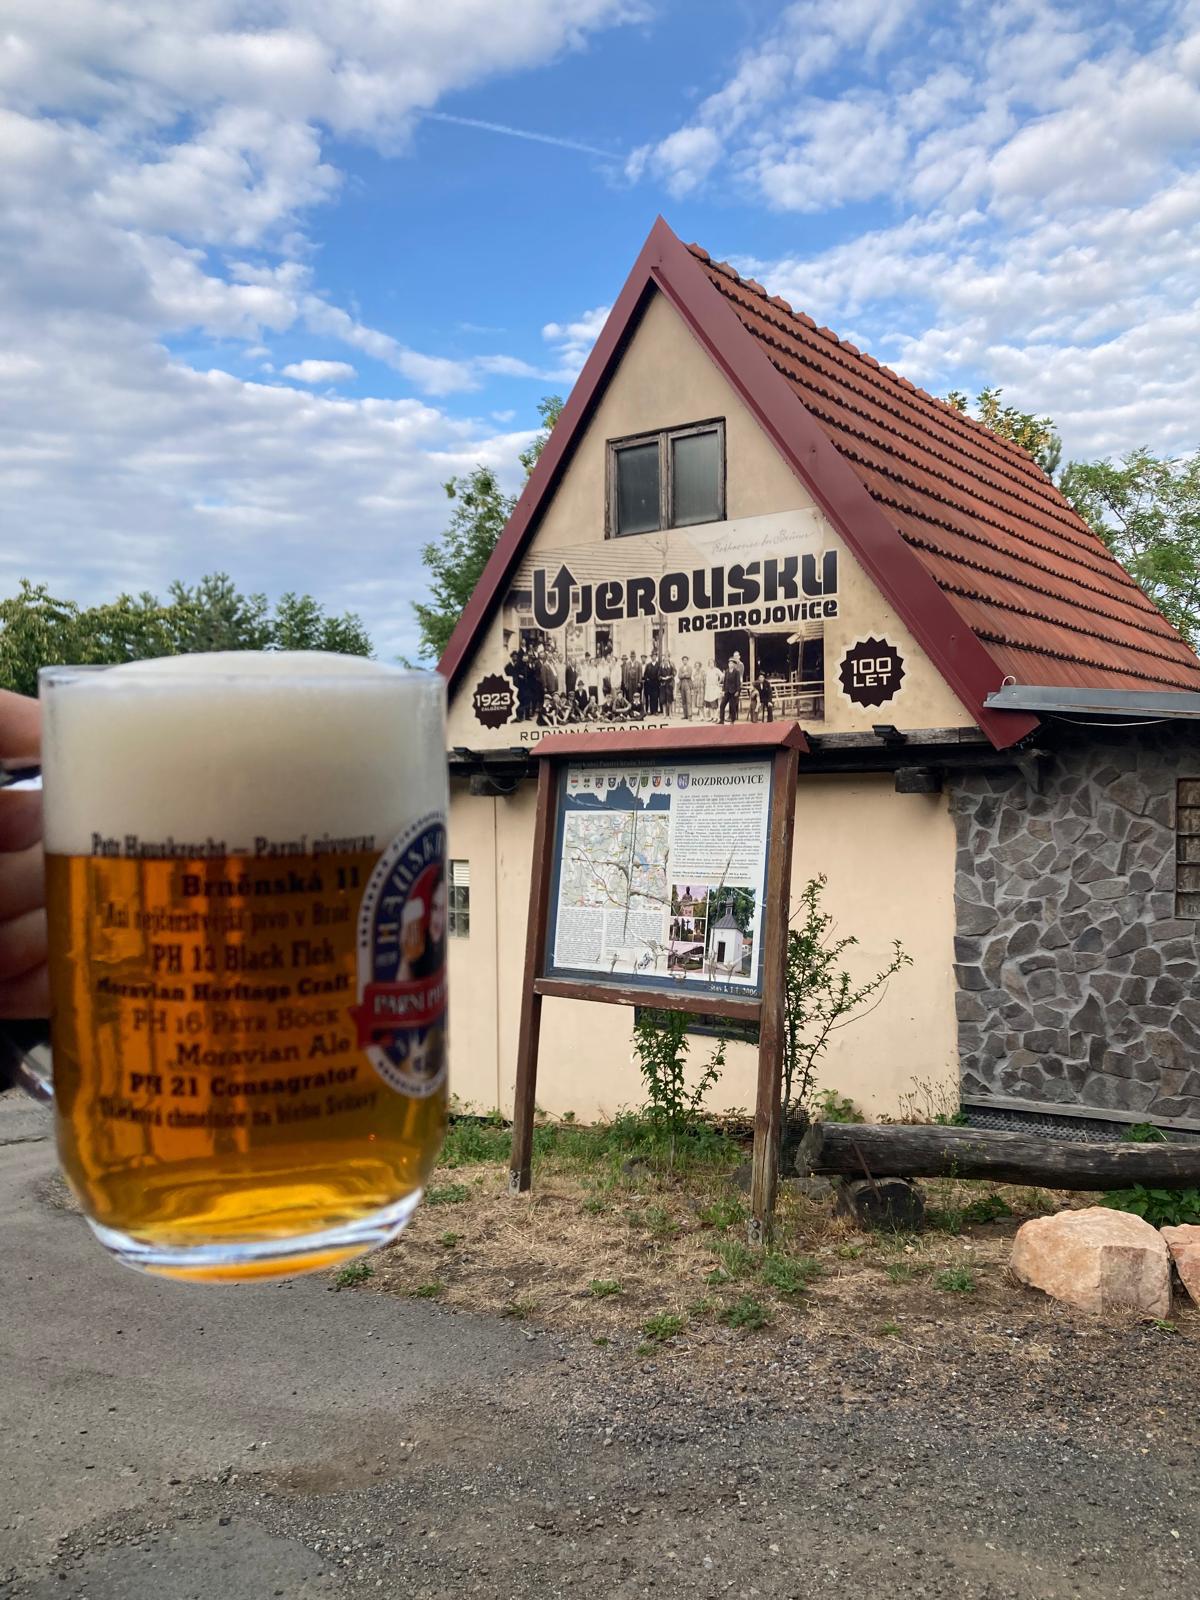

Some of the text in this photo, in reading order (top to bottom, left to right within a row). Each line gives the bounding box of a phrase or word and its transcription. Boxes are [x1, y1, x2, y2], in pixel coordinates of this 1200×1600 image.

[850, 657, 892, 675] 100
[853, 673, 892, 688] LET
[475, 692, 511, 707] 1923
[691, 774, 764, 787] ROZDROJOVICE
[181, 865, 359, 897] Brněnská 11
[152, 943, 183, 974] PH
[192, 943, 217, 972] 13
[224, 941, 285, 973] Black
[132, 1006, 167, 1034] PH
[175, 1011, 202, 1035] 16
[176, 1030, 351, 1068] Moravian Ale
[129, 1071, 162, 1096] PH
[170, 1075, 198, 1098] 21
